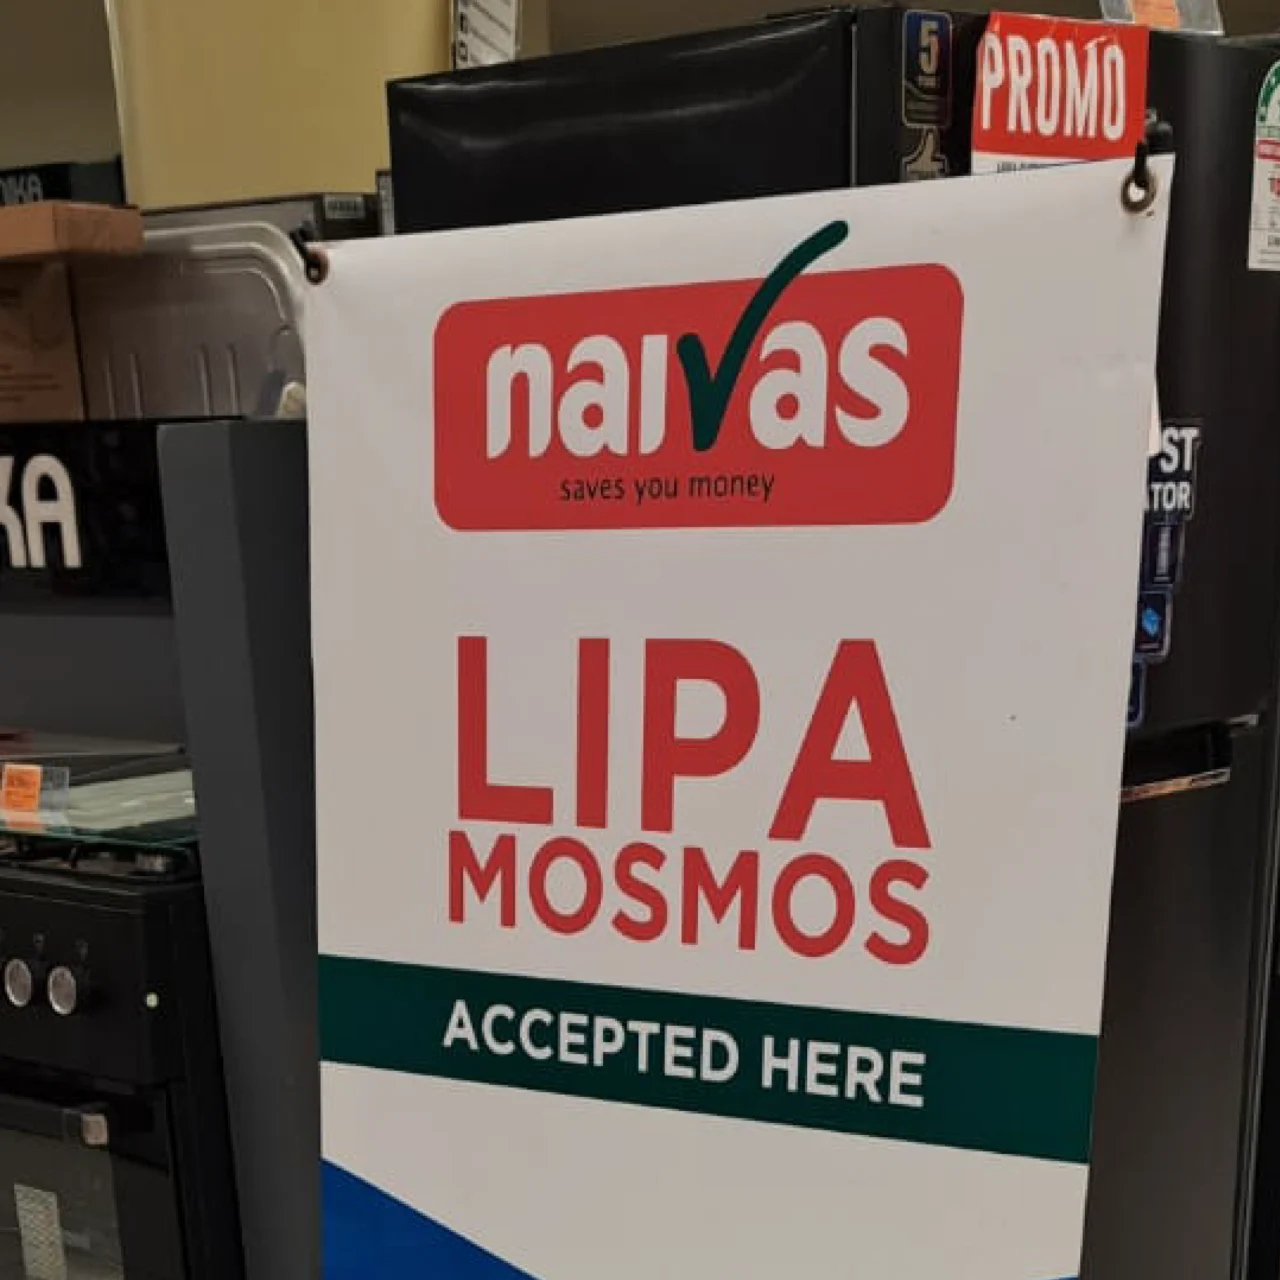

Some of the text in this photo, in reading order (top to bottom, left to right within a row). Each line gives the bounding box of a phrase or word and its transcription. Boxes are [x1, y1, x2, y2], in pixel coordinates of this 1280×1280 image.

[919, 21, 939, 75] 5
[981, 32, 1126, 141] PROMO
[486, 221, 911, 459] naivas
[559, 472, 775, 505] saves you money
[1151, 481, 1190, 511] TOR
[1160, 427, 1199, 473] ST
[457, 636, 932, 848] LIPA
[448, 830, 930, 965] MOSMOS
[442, 999, 927, 1107] ACCEPTED HERE
